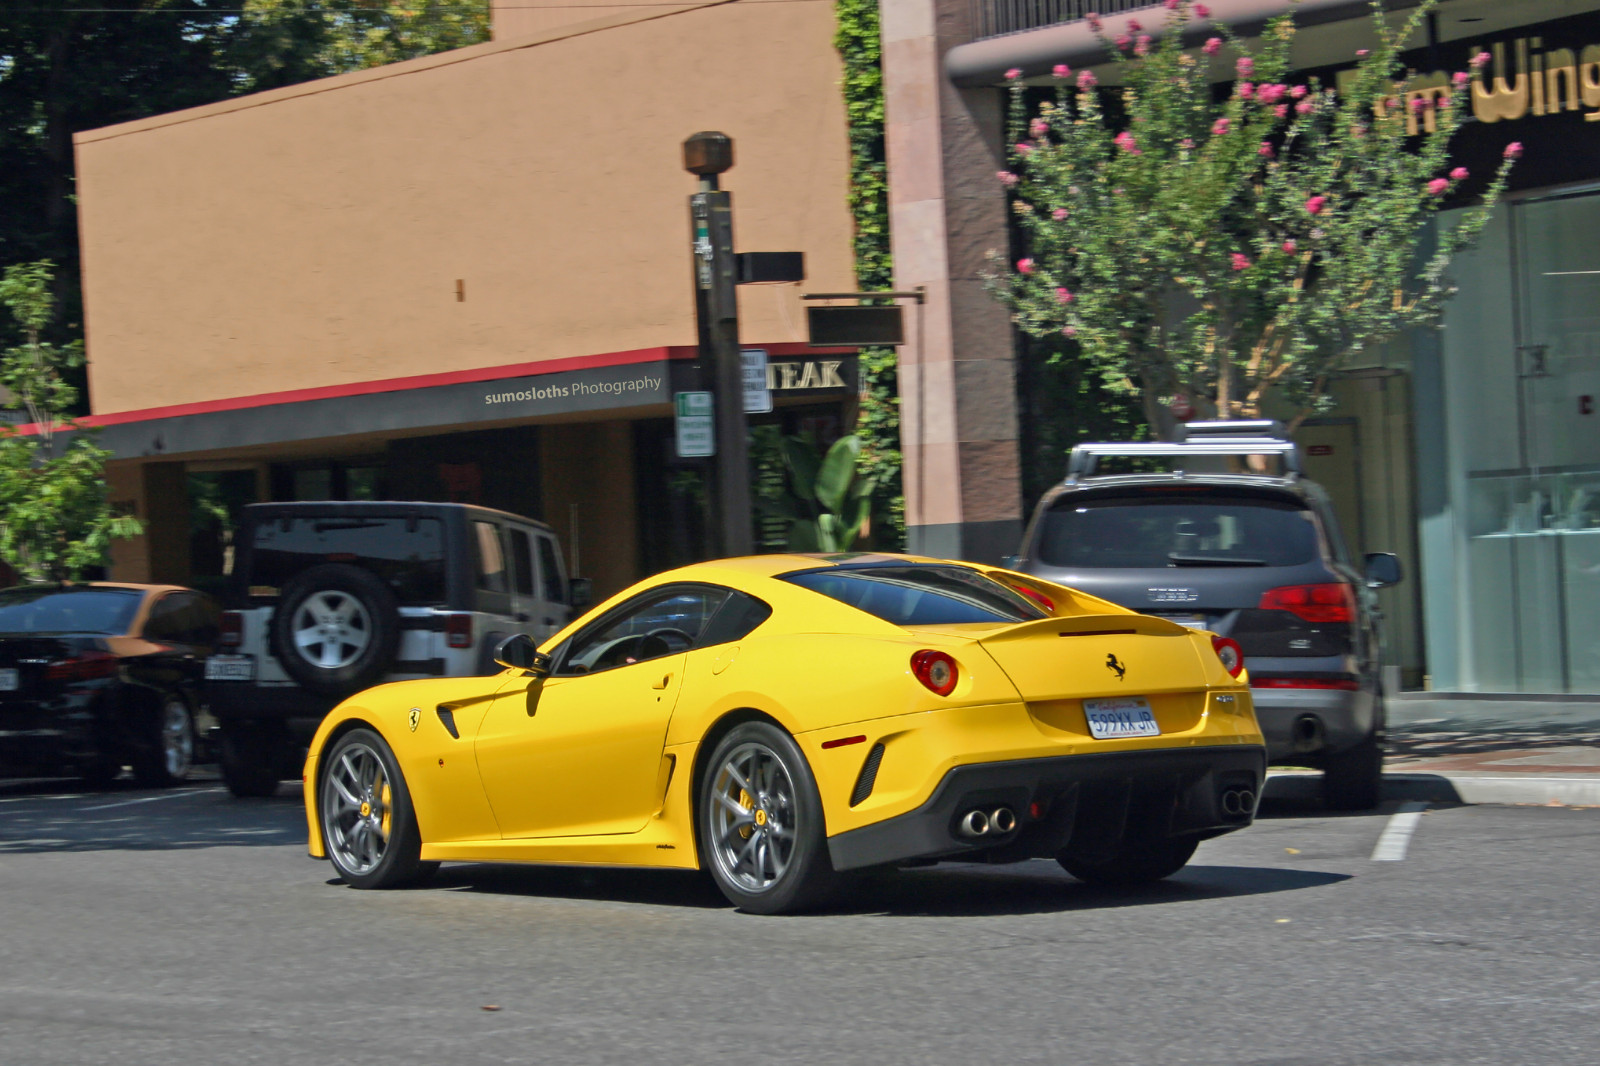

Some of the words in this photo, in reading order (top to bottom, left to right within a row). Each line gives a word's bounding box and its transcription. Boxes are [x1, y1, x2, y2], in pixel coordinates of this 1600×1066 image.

[485, 385, 569, 405] sumosloths
[571, 376, 662, 397] Photography
[1090, 711, 1136, 732] 599XX
[1138, 711, 1155, 730] JR
